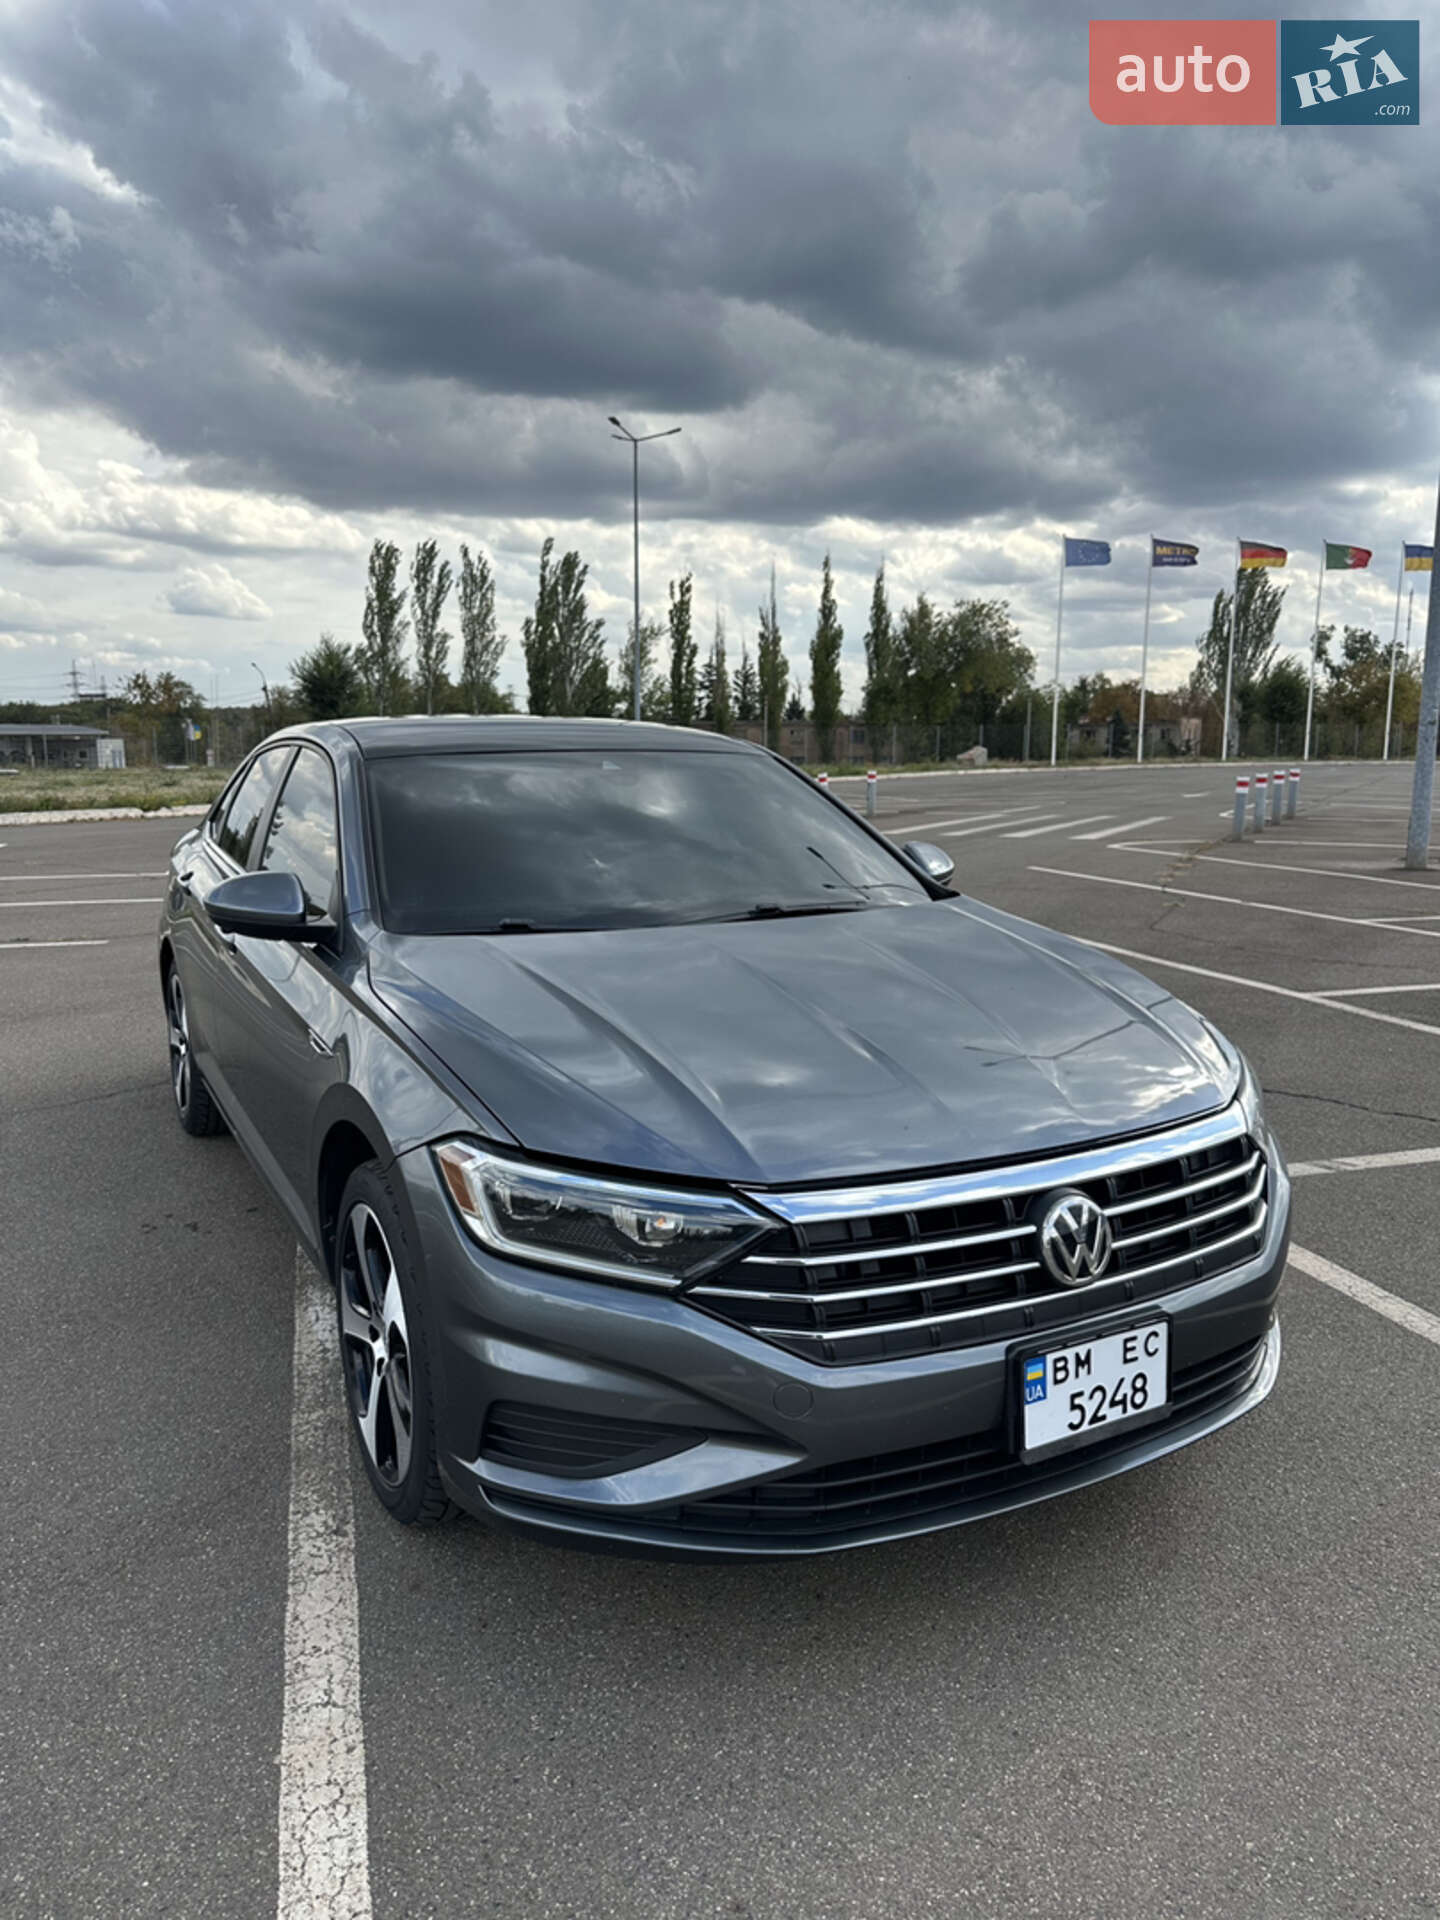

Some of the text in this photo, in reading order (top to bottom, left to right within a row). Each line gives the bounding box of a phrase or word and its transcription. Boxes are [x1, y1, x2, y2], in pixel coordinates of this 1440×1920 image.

[1052, 1330, 1160, 1386] BM EC
[1026, 1385, 1045, 1402] UA
[1067, 1372, 1149, 1431] 5248
